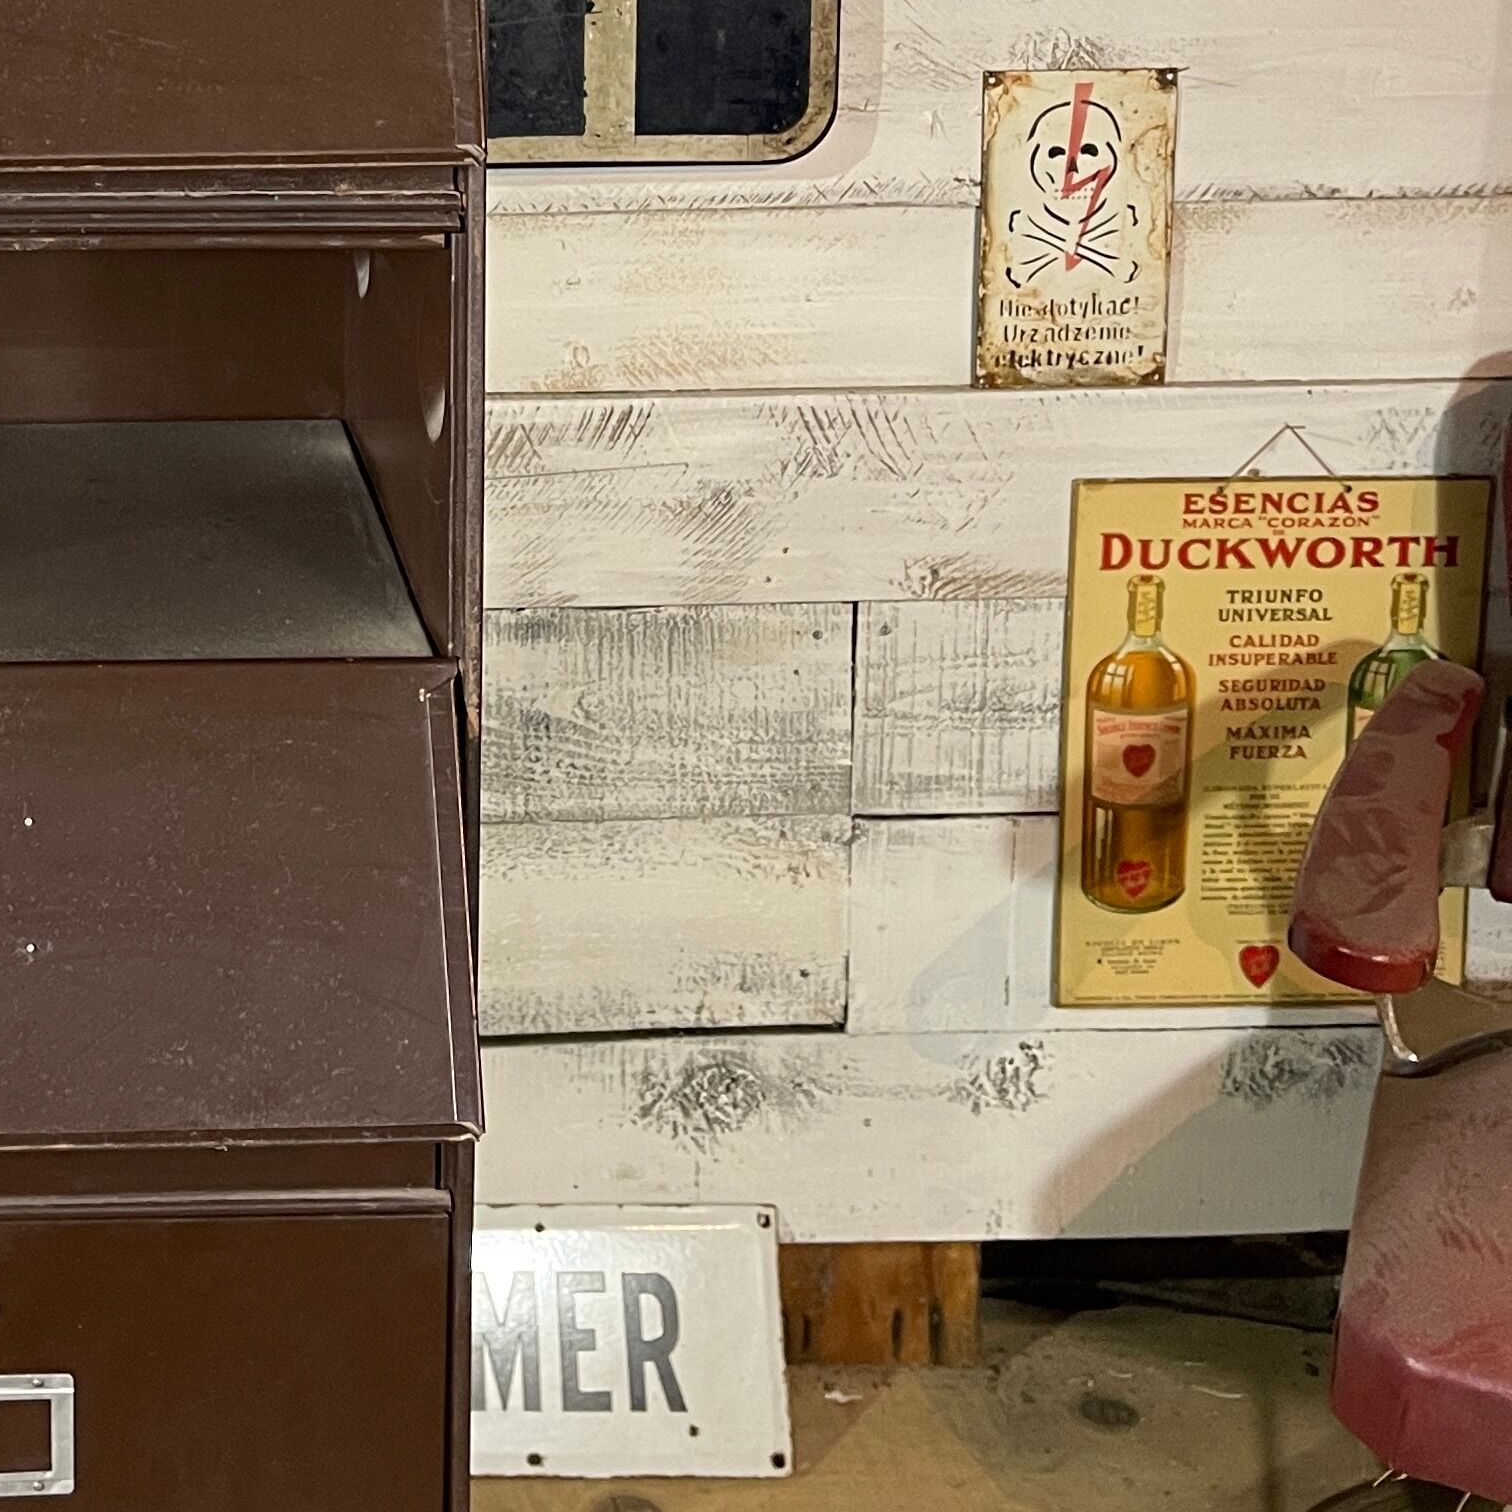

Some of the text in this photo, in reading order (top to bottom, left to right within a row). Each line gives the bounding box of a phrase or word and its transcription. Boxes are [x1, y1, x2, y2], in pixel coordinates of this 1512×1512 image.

[1182, 491, 1379, 515] ESENCIAS
[1182, 517, 1253, 529] MARCA
[1099, 532, 1460, 571] DUCKWORTH
[1226, 589, 1323, 604] TRIUNFO
[1218, 608, 1333, 622] UNIVERSAL
[1229, 634, 1320, 648] CALIDAD
[1208, 651, 1338, 667] INSUPERABLE
[1218, 678, 1326, 693] SEGURIDAD
[1220, 697, 1322, 712] ABSOLUTA
[1229, 744, 1308, 760] FUERZA
